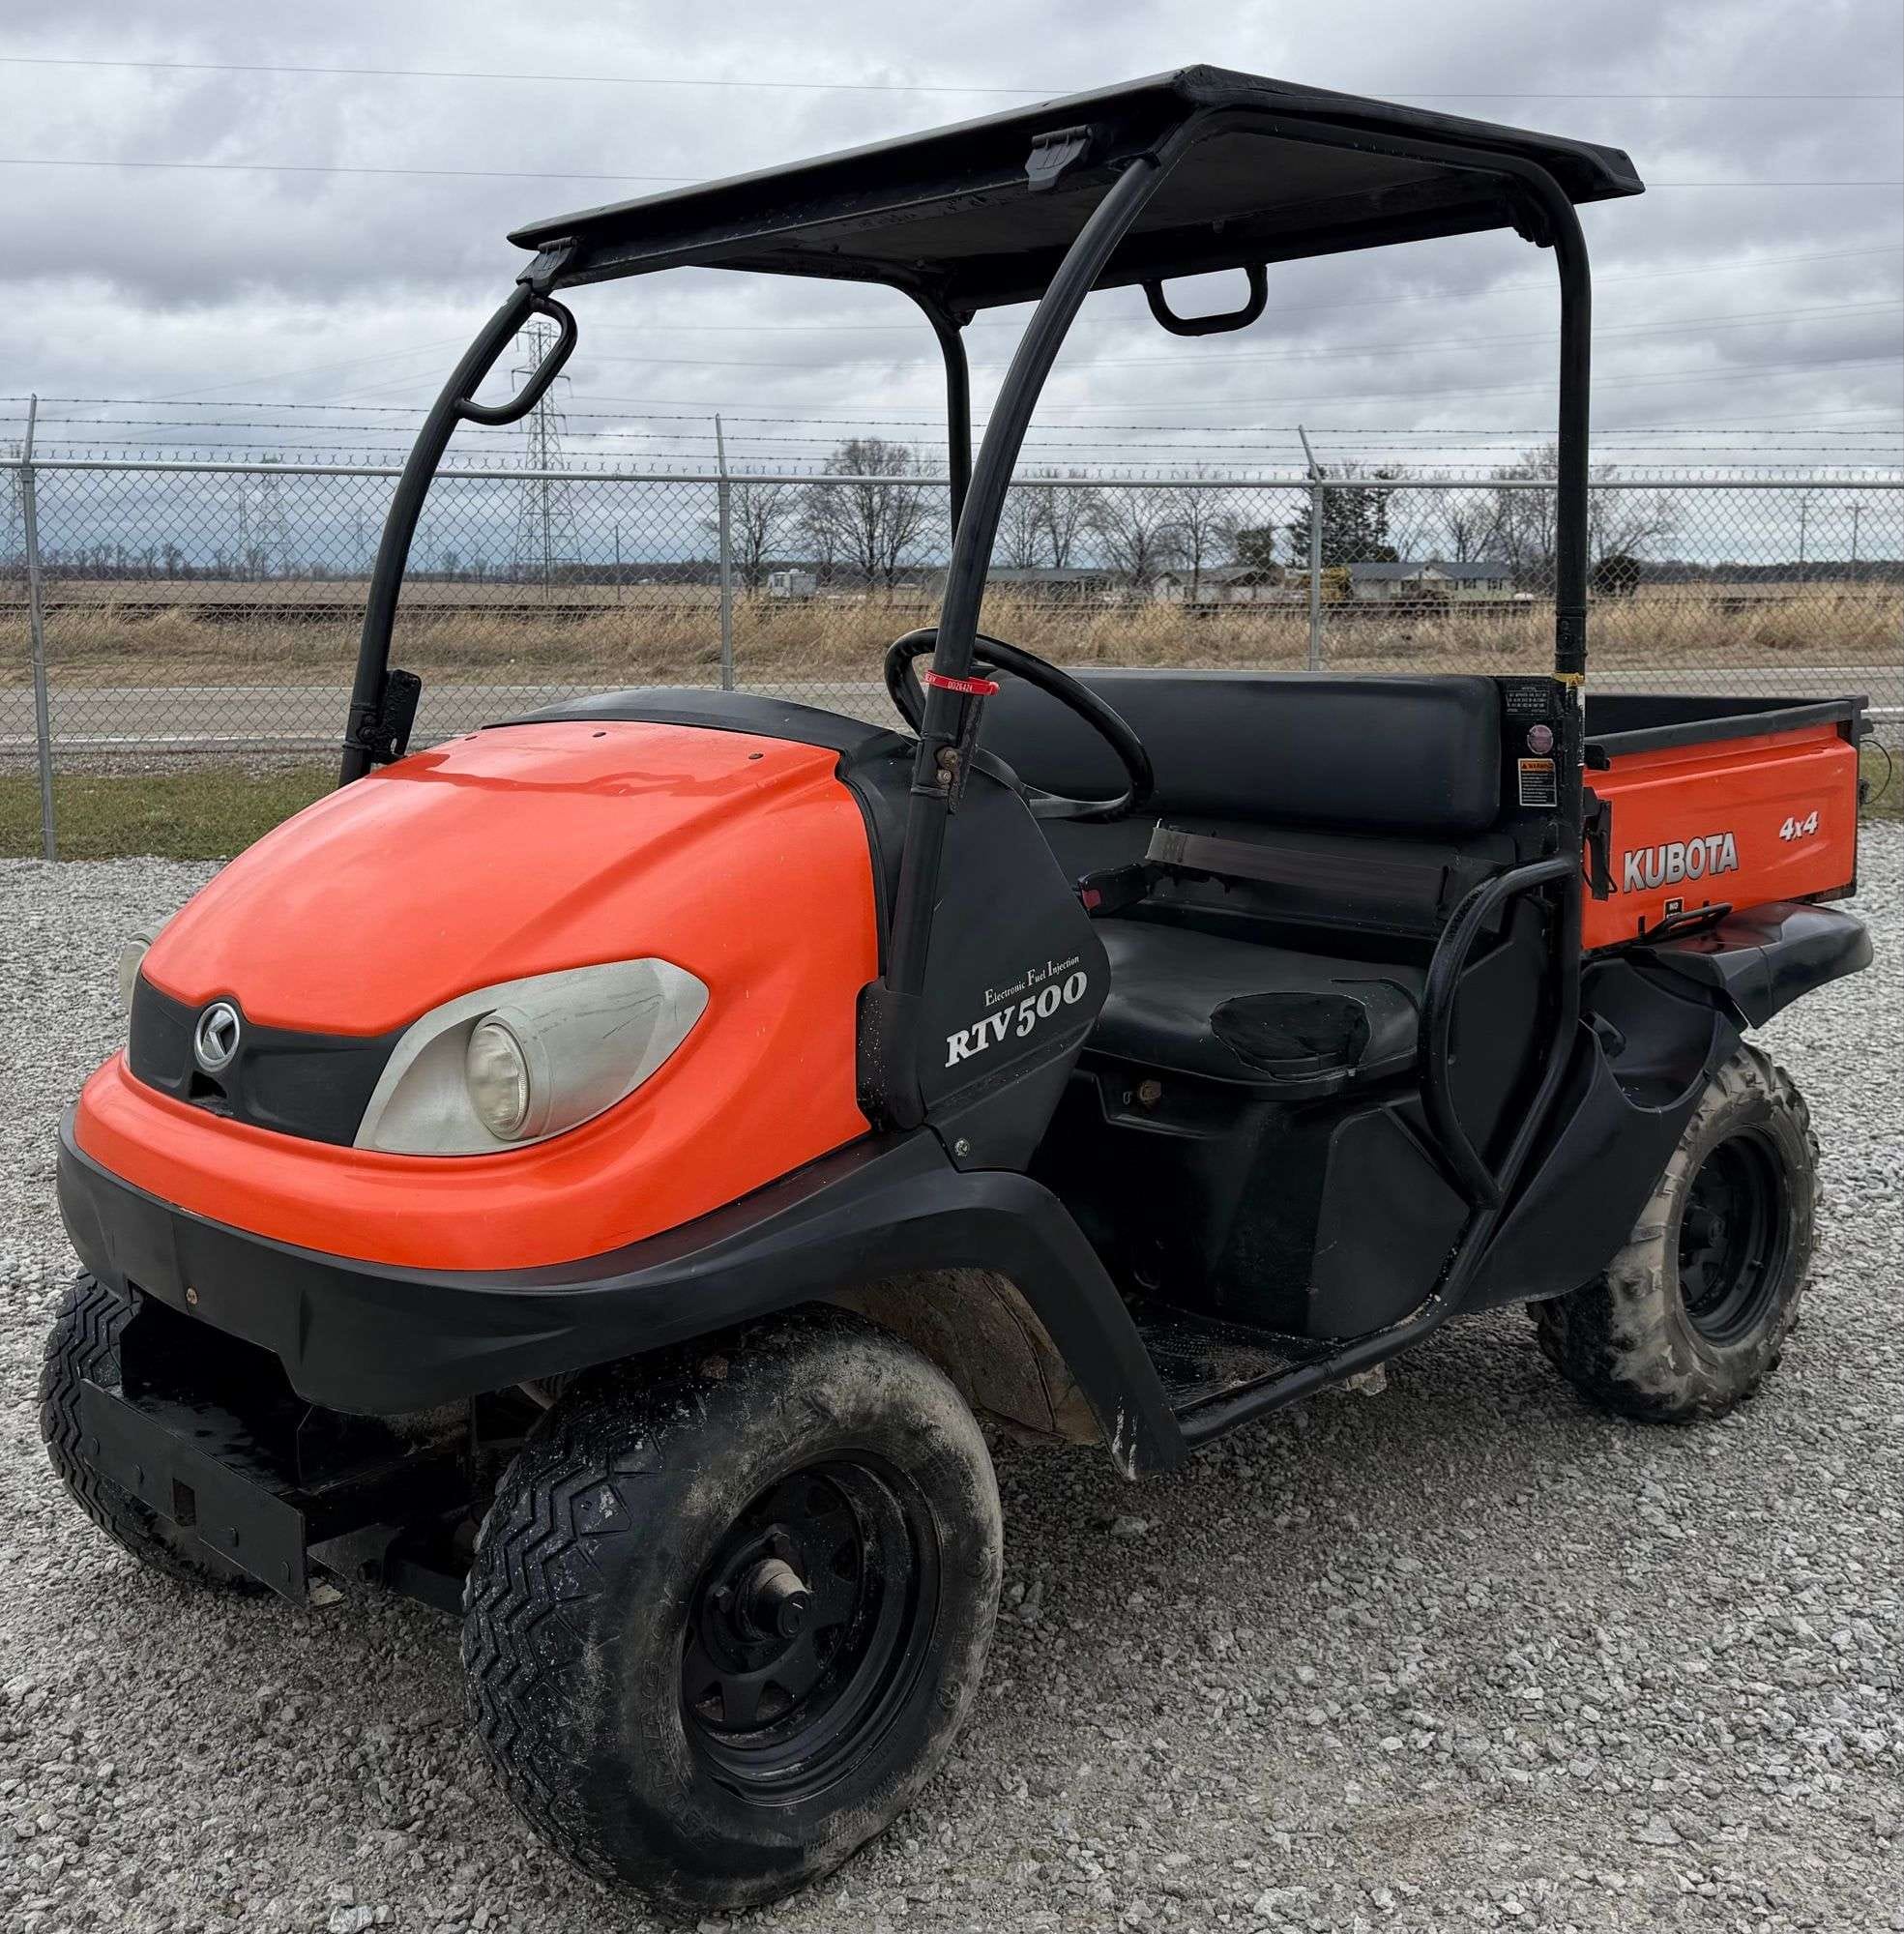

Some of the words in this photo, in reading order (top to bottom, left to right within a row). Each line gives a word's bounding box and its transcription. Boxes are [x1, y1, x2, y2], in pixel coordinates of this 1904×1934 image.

[1778, 810, 1819, 842] 4x4
[1623, 831, 1740, 894] KUBOTA
[984, 982, 1026, 1007] Electronic
[1026, 968, 1046, 987] Fuel
[1046, 955, 1080, 978] Injection
